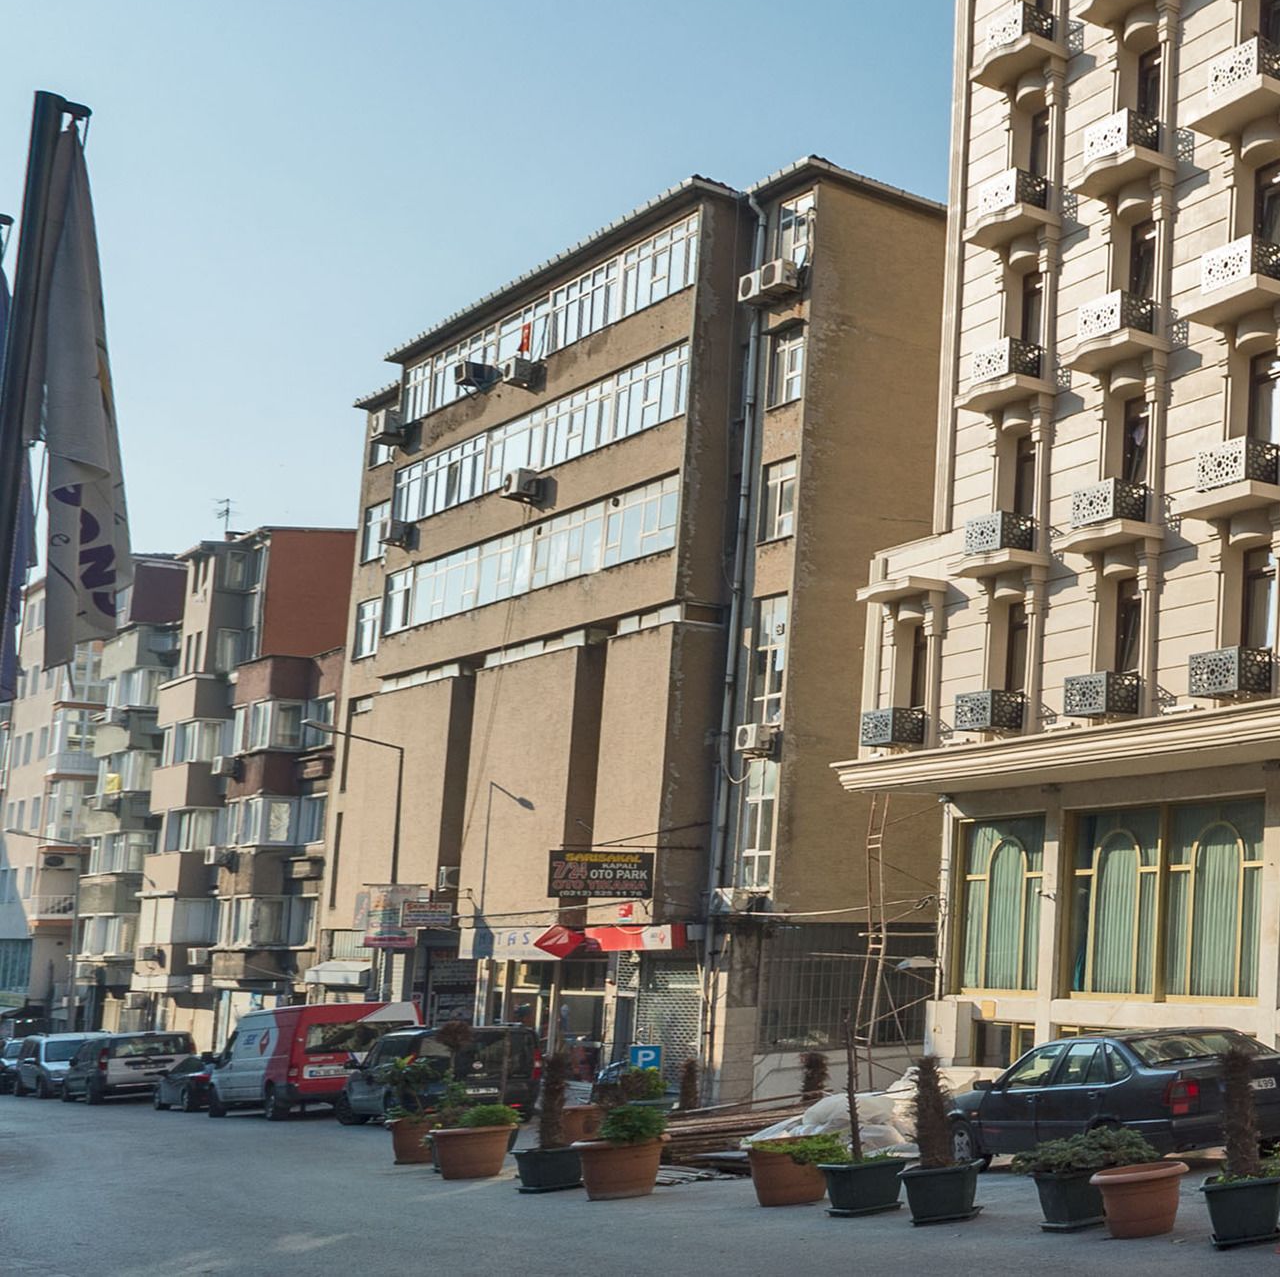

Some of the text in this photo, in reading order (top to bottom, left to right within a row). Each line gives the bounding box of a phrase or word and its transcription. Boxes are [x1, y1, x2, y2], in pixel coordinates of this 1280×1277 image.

[552, 861, 588, 879] 7/24
[590, 869, 648, 880] OTO PARK
[551, 879, 585, 890] OTO
[637, 1050, 655, 1069] P
